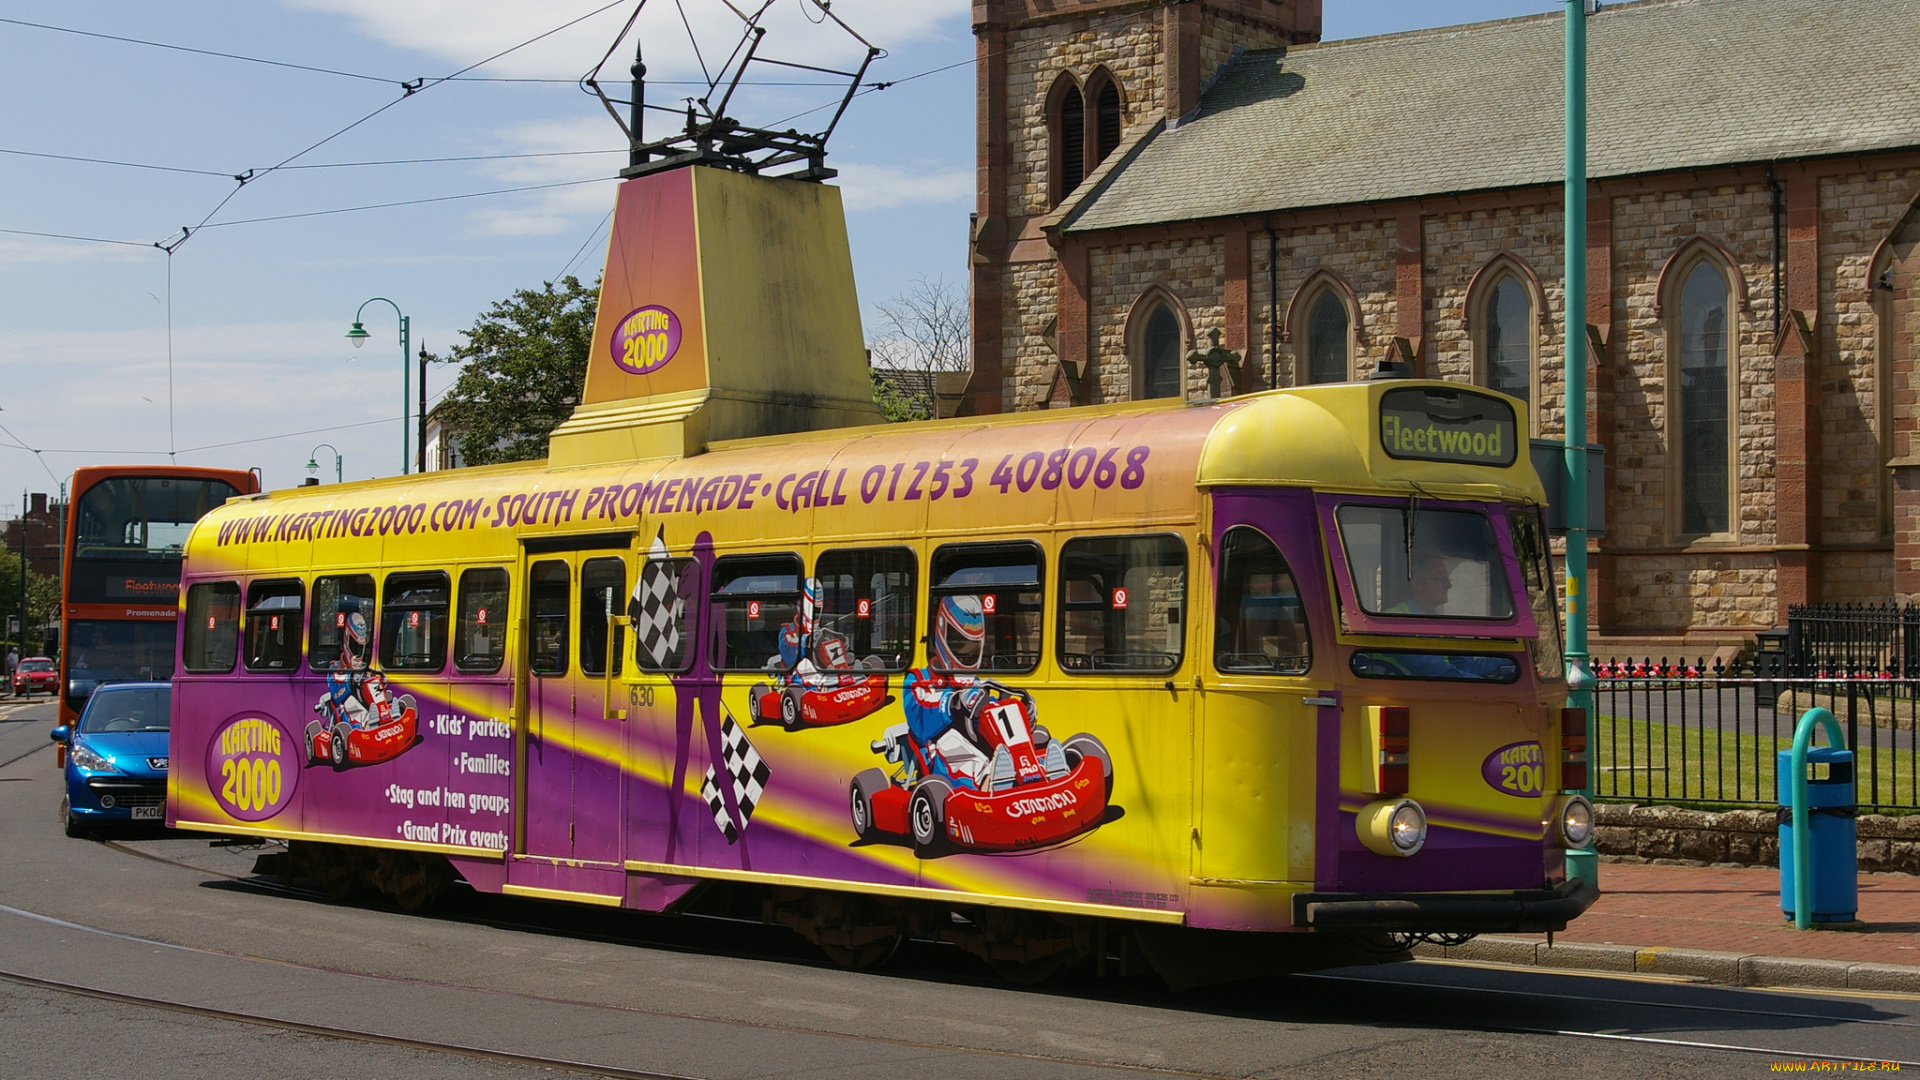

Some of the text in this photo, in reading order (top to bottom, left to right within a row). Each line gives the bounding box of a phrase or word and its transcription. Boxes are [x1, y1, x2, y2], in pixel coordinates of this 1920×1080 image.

[624, 309, 669, 337] KARTING
[622, 332, 668, 369] 2000
[1382, 415, 1502, 457] Fleetwood
[217, 445, 1151, 547] WWW.KARTING2000.COM SOUTH PROMENADE CALL 01253 408068
[126, 609, 176, 617] Promenade
[630, 685, 655, 707] 630
[222, 718, 281, 756] KARTING
[469, 717, 511, 741] parties
[997, 708, 1015, 740] 1
[460, 751, 511, 776] Families
[1501, 744, 1542, 765] KART
[222, 757, 282, 812] 2000
[389, 784, 510, 817] Stag and hen groups
[403, 820, 509, 851] Grand Prix events
